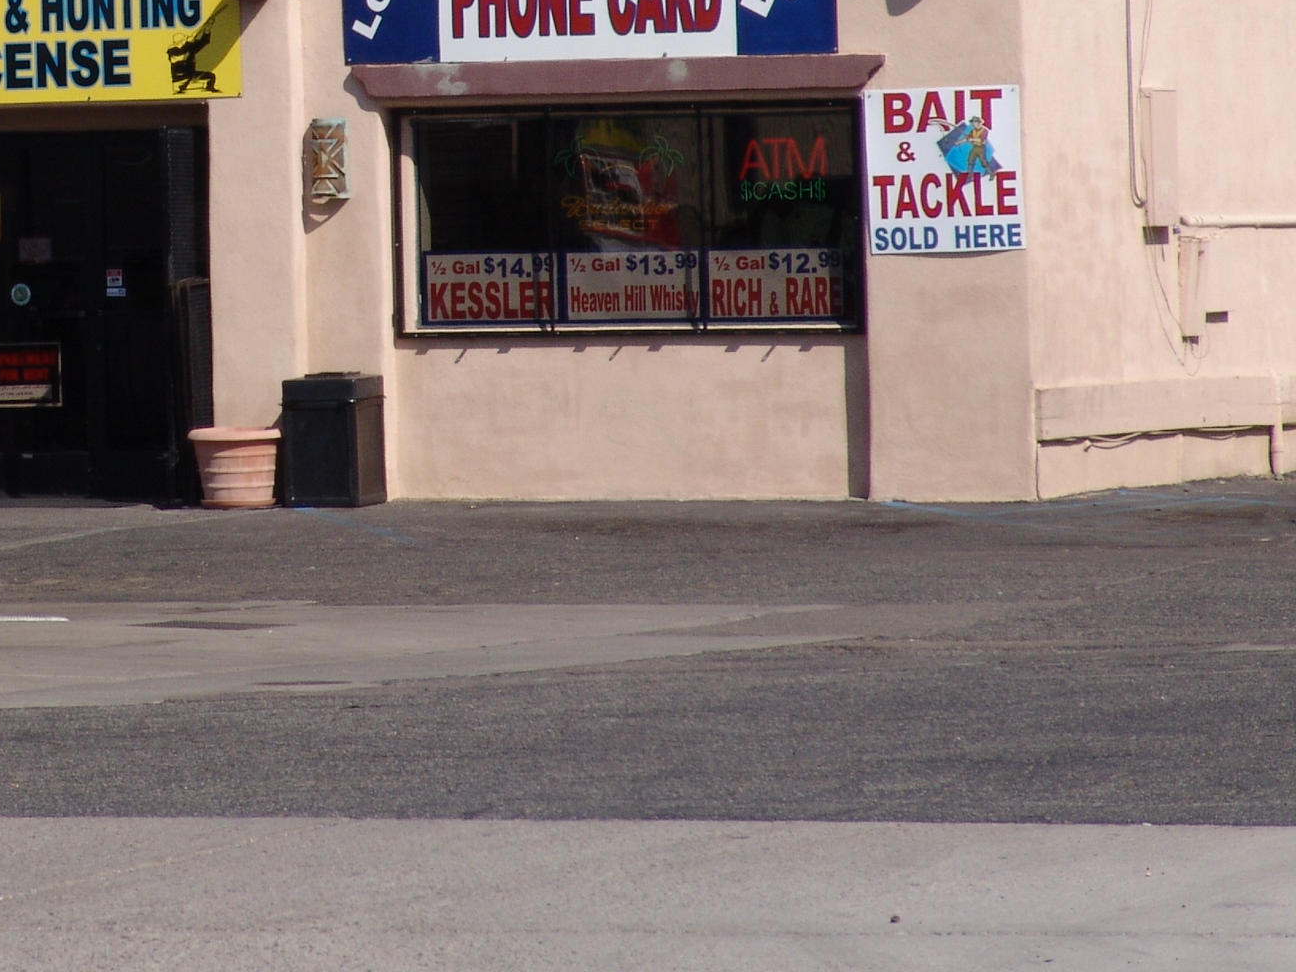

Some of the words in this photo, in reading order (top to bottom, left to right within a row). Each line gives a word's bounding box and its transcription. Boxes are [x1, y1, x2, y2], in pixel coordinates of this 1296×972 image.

[883, 89, 1002, 134] BAIT
[738, 136, 827, 180] ATM
[896, 141, 916, 162] &
[740, 177, 826, 201] $CASH$
[872, 171, 1019, 219] TACKLE
[875, 226, 939, 251] SOLD
[955, 223, 1022, 249] HERE
[452, 260, 481, 275] Gal
[591, 257, 620, 272] Gal
[625, 253, 697, 275] $13.99
[735, 255, 765, 270] Gal
[768, 251, 841, 274] $12.99
[430, 281, 553, 320] KESSLER
[570, 285, 620, 313] Heaven
[624, 284, 646, 312] Hill
[650, 284, 699, 317] Whisky
[712, 278, 762, 317] RICH
[769, 290, 780, 316] &
[786, 277, 842, 316] RARE
